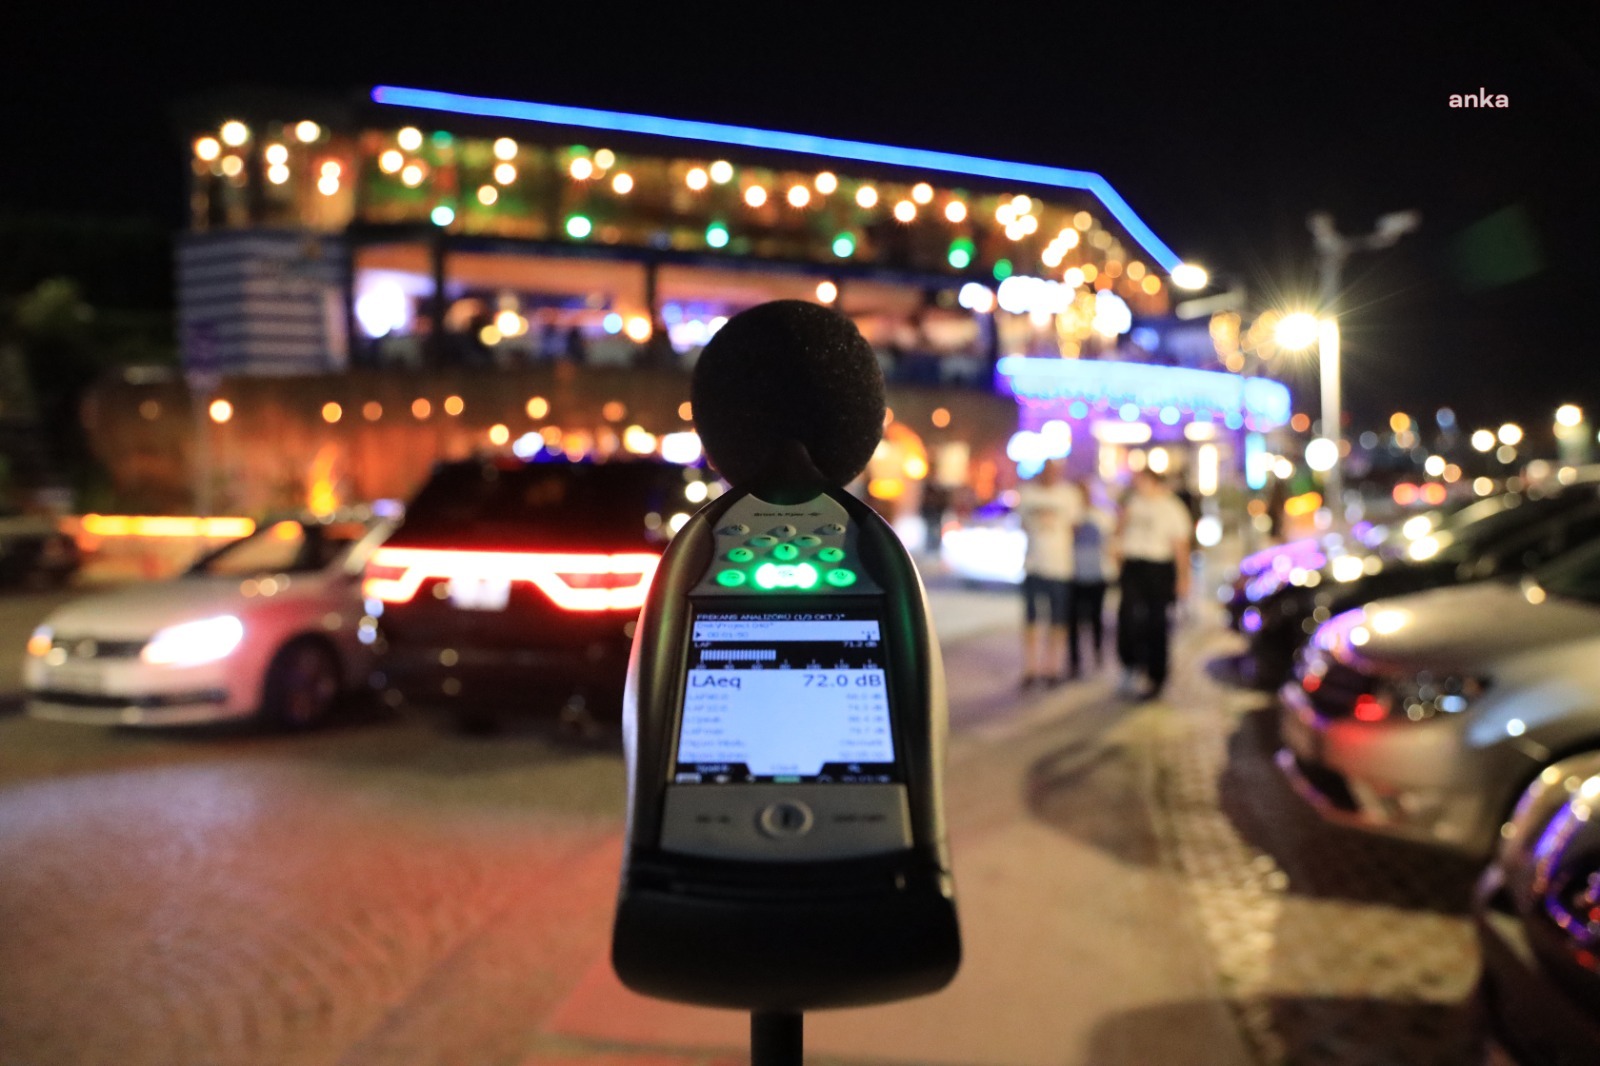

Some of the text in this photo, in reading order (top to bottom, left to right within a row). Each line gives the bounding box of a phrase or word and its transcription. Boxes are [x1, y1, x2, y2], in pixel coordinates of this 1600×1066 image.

[692, 674, 741, 690] LAeq
[802, 674, 882, 688] 72.0 dB
